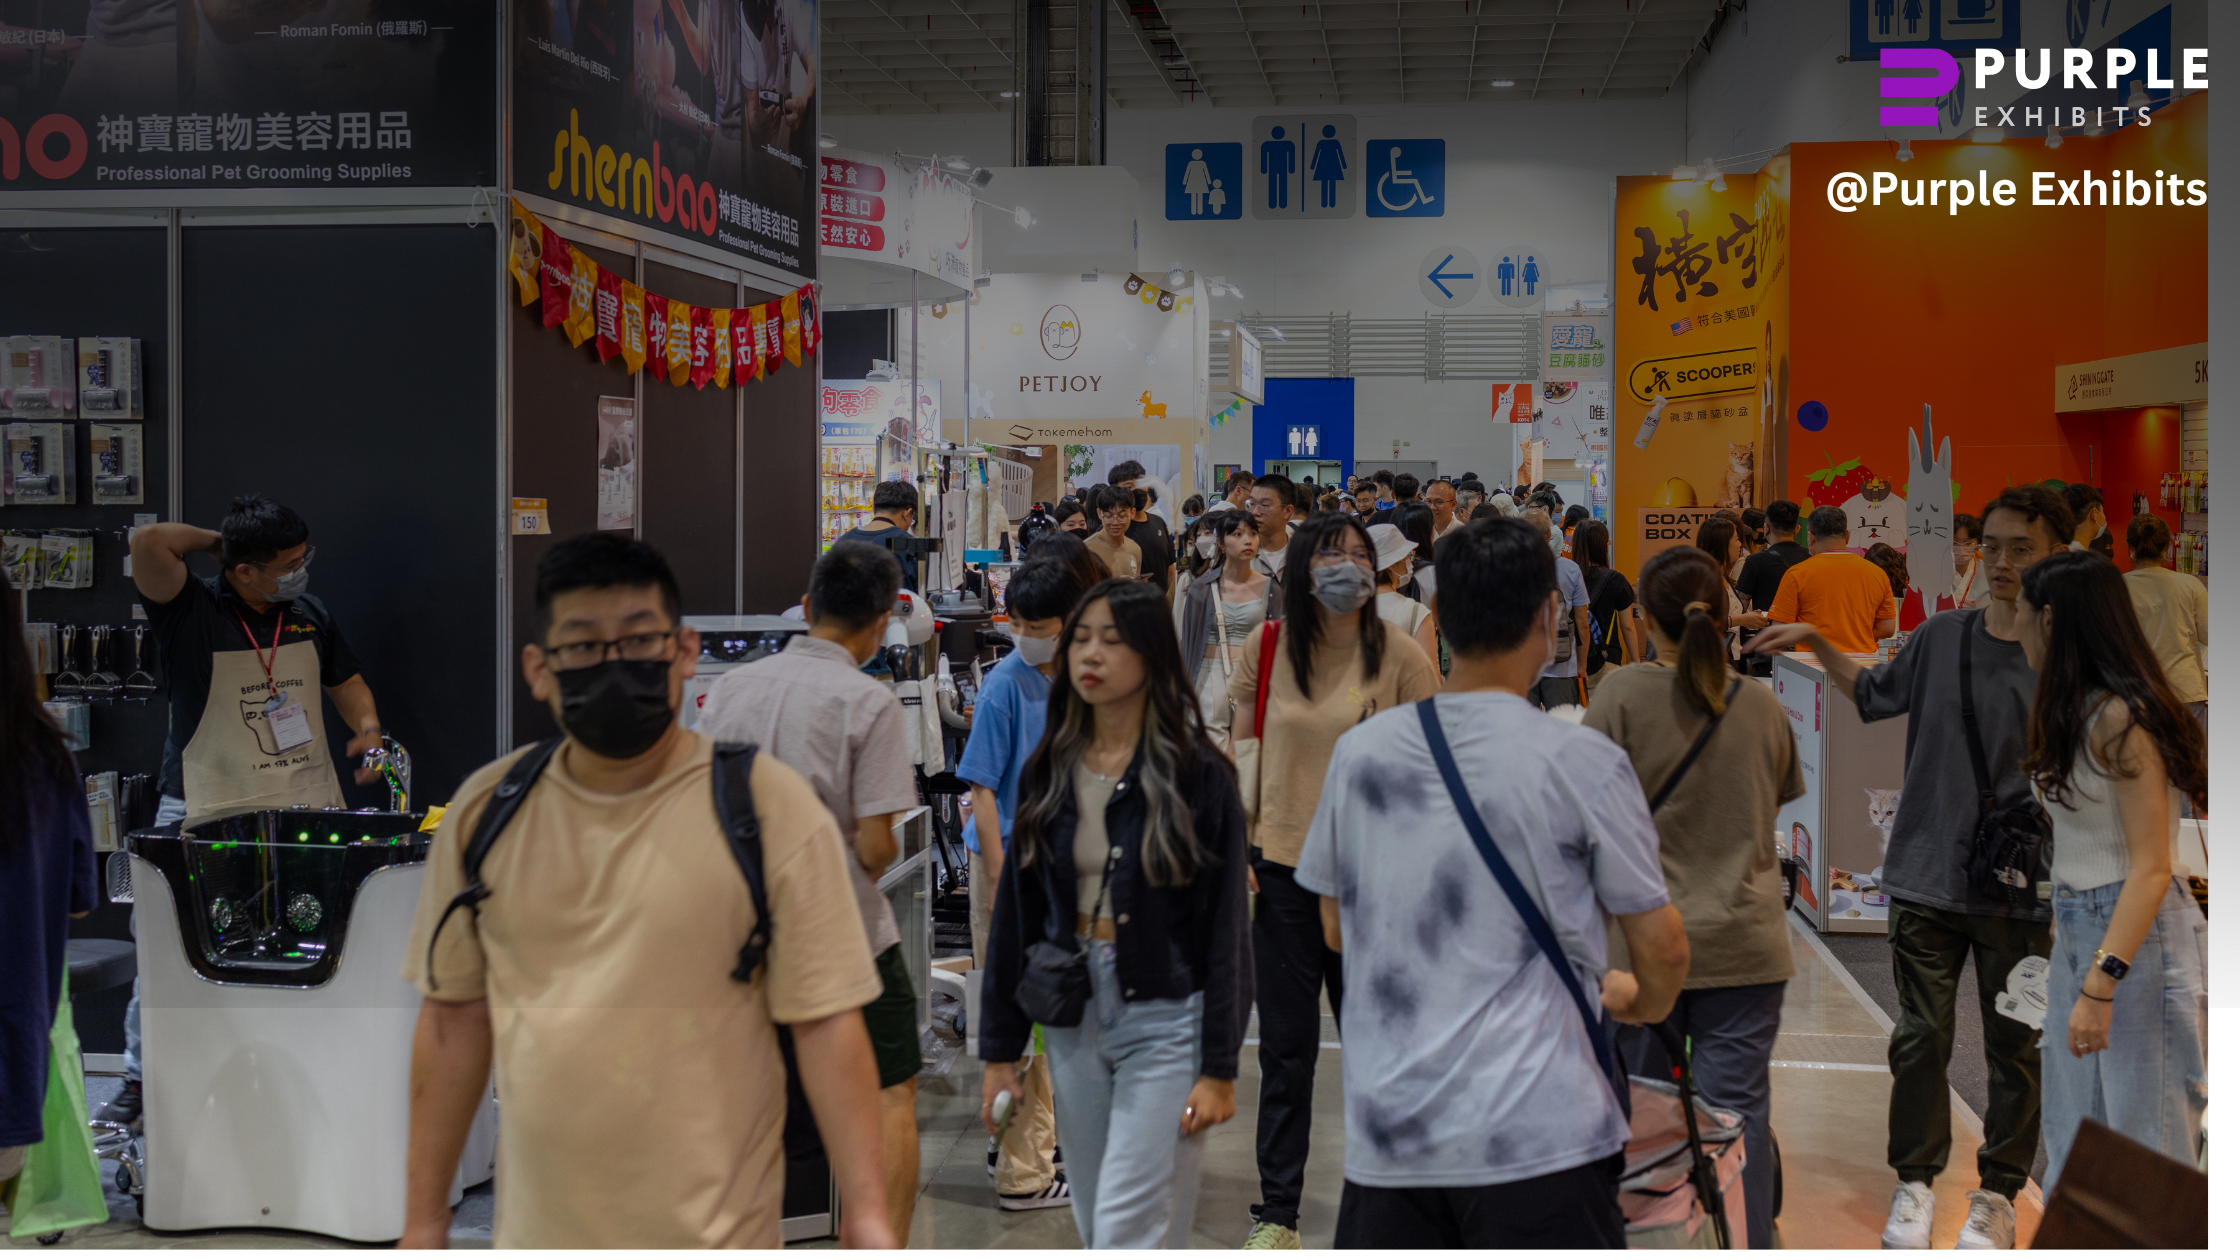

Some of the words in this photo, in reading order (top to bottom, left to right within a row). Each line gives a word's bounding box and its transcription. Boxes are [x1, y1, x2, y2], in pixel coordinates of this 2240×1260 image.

[29, 28, 66, 45] (日本)
[280, 25, 328, 38] Roman
[331, 22, 373, 36] Fomin
[376, 20, 428, 37] (俄羅斯)
[538, 36, 551, 53] Luis
[551, 42, 570, 62] Martin
[570, 51, 580, 66] Del
[580, 55, 590, 70] Rio
[96, 111, 413, 154] 神寶寵物美容用品
[96, 165, 207, 182] Professional
[211, 164, 243, 180] Pet
[246, 163, 333, 182] Grooming
[336, 162, 412, 182] Supplies
[547, 107, 718, 237] shernbao
[718, 188, 800, 248] 神寶寵物美容用品
[718, 229, 750, 251] Professional
[749, 240, 759, 255] Pet
[759, 244, 781, 264] Grooming
[780, 251, 799, 268] Supplies
[1548, 353, 1606, 368] 豆腐貓砂
[1019, 375, 1102, 393] PETJOY
[521, 516, 537, 529] 150
[1645, 528, 1692, 540] BOX
[241, 681, 271, 695] BEFORE
[275, 679, 304, 688] COFFEE
[291, 754, 310, 765] ALIVE
